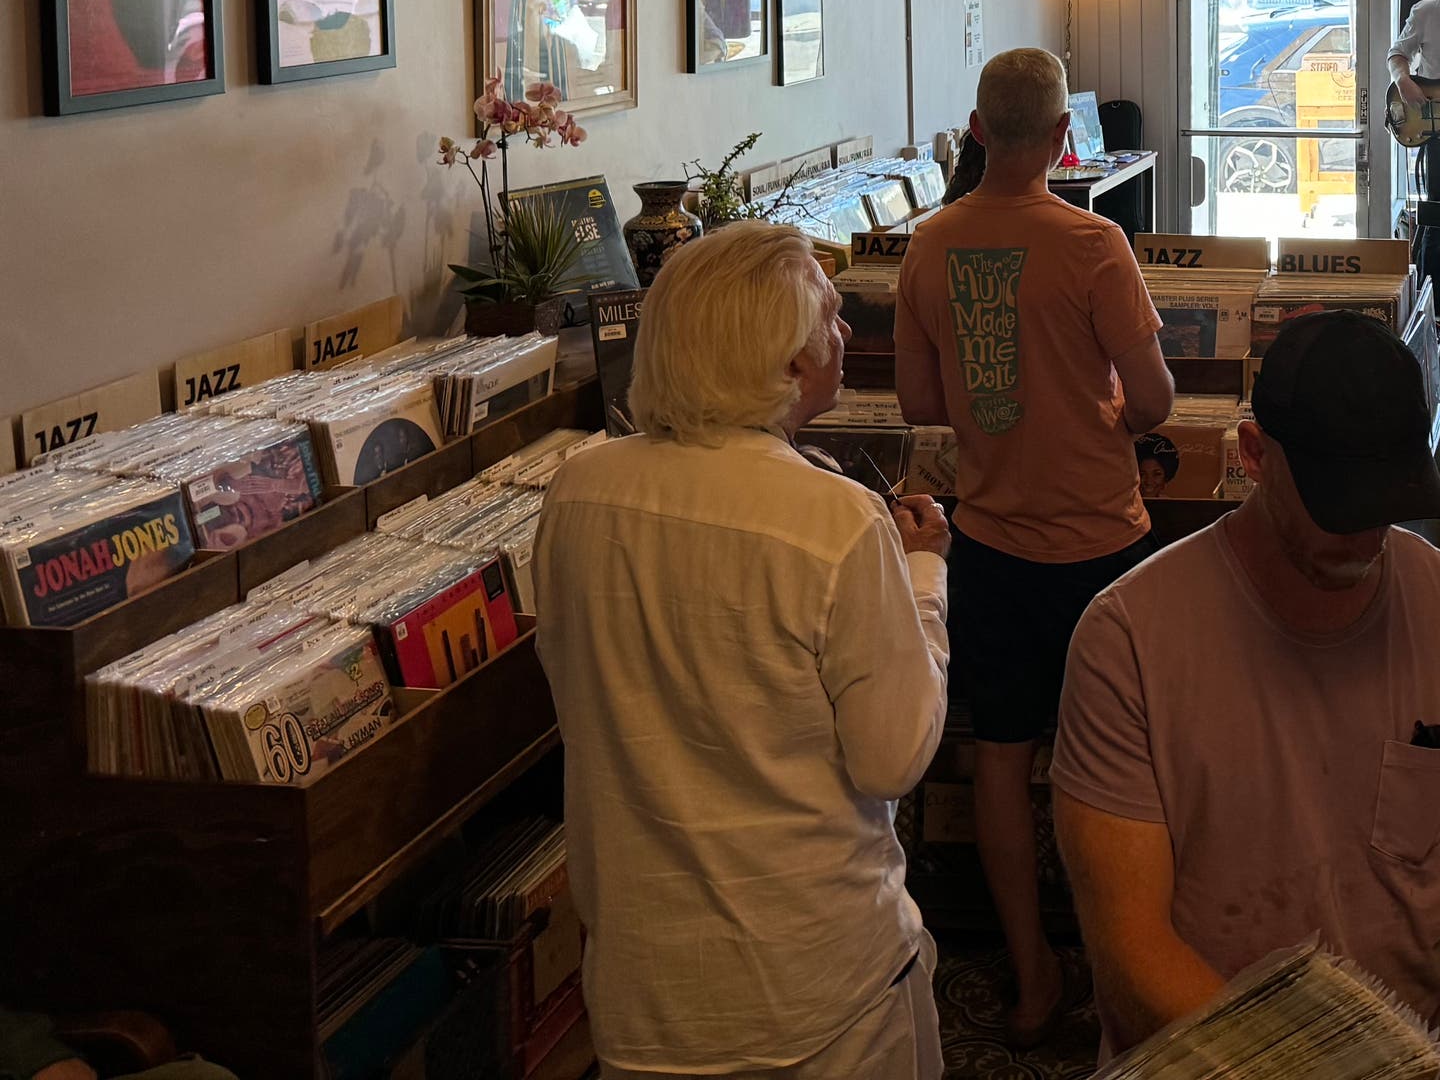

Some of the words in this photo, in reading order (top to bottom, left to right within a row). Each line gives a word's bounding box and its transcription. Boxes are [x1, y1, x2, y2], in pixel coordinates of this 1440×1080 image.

[1360, 90, 1368, 116] PUSH
[1143, 248, 1203, 268] JAZZ
[1281, 254, 1361, 274] BLUES
[599, 303, 642, 323] MILES
[1196, 295, 1220, 303] SERIES
[311, 327, 359, 365] JAZZ
[184, 363, 242, 406] JAZZ
[34, 412, 98, 454] JAZZ
[34, 539, 114, 597] JONAH
[111, 513, 180, 567] JONES
[355, 679, 385, 701] SONGS
[349, 717, 382, 747] HYMAN
[260, 712, 312, 784] 60
